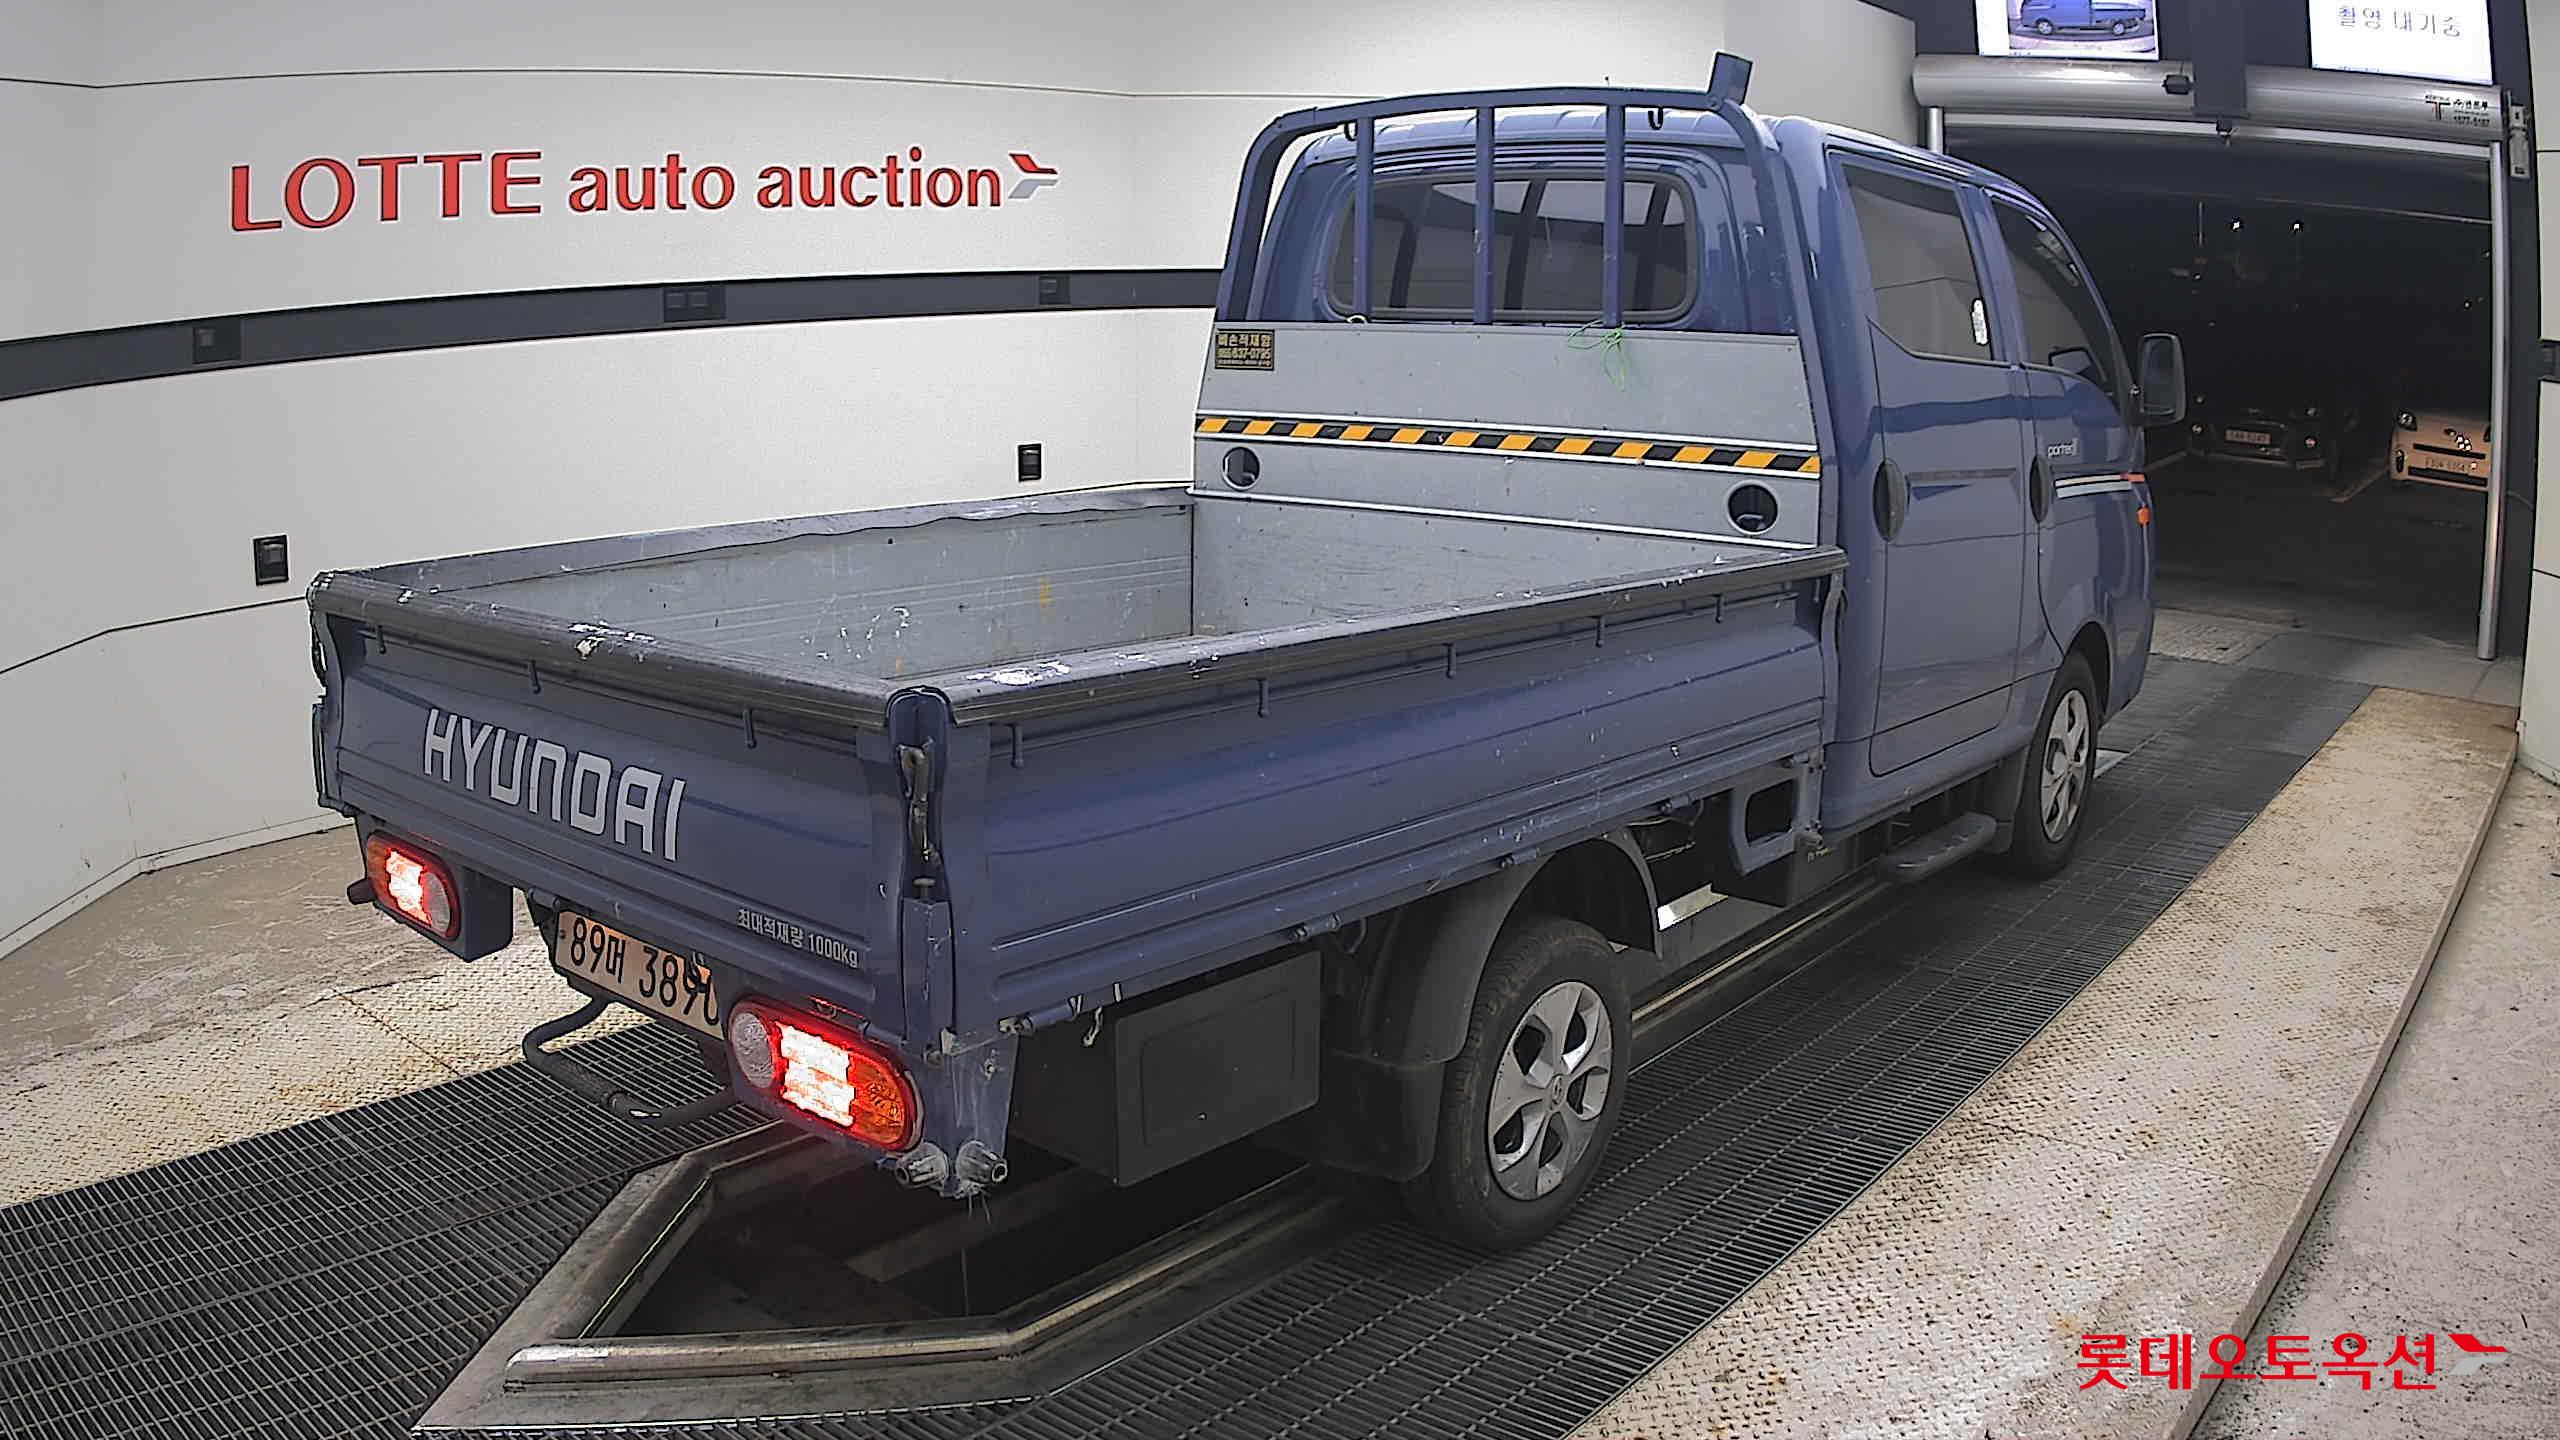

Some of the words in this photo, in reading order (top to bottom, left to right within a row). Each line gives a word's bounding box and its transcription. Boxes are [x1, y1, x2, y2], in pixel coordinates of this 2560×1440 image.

[232, 152, 541, 231] LOTTE
[569, 154, 735, 212] auto
[757, 147, 1002, 207] auction
[423, 707, 687, 863] HYUNDAI
[570, 916, 627, 985] 89머
[737, 908, 804, 949] 최대적재량
[808, 933, 859, 969] 1000kg
